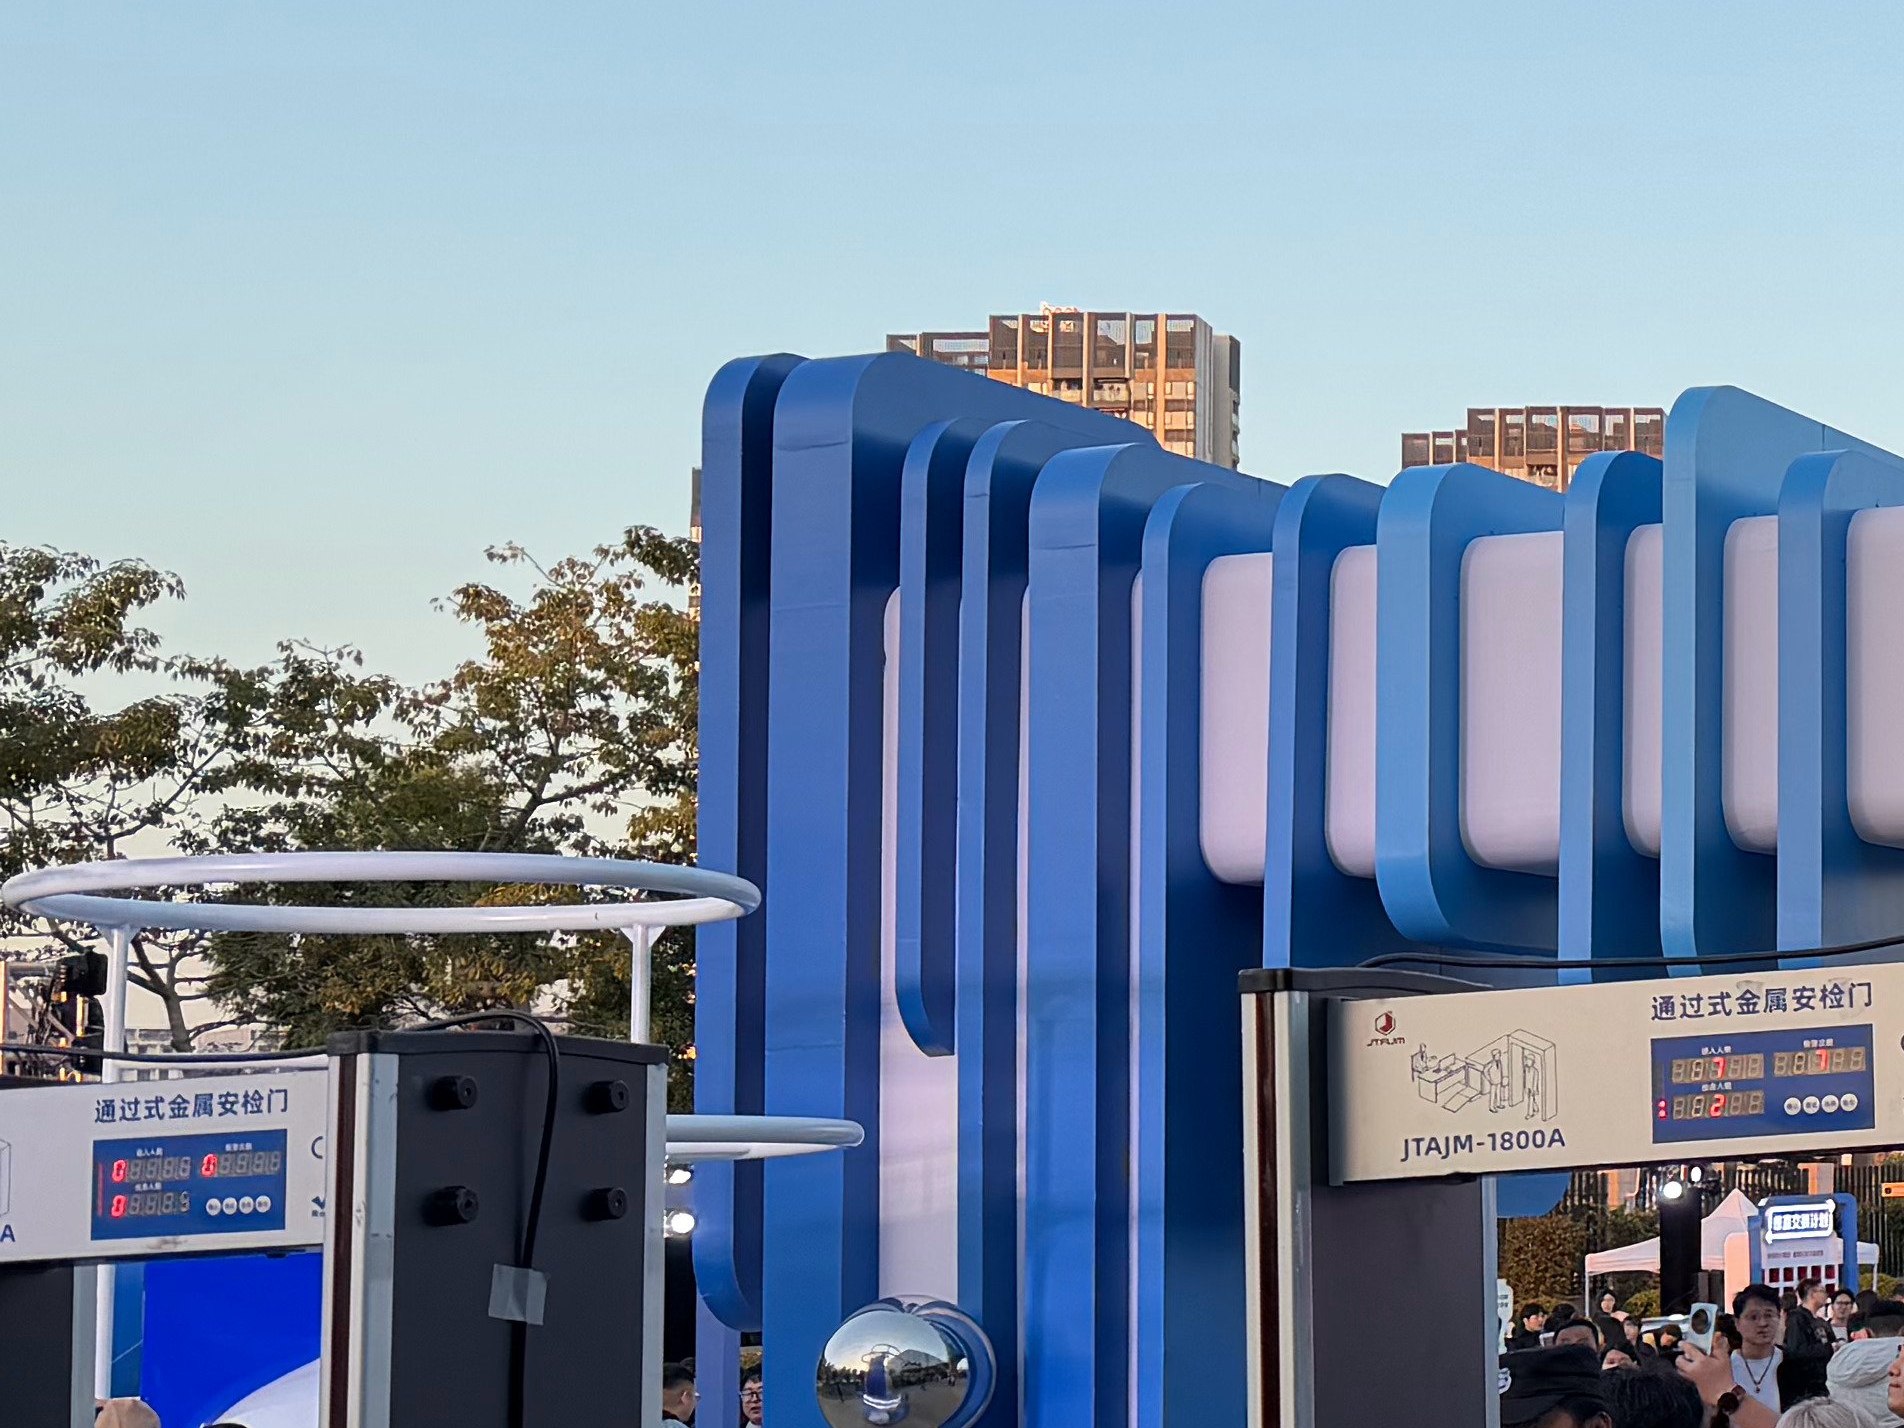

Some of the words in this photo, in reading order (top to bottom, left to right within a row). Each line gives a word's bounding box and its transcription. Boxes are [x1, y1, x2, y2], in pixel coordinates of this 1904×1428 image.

[1650, 981, 1873, 1022] 通过式金属安检门
[94, 1088, 289, 1123] 通过式金属安检门
[1400, 1128, 1566, 1162] JTAJM-1800A
